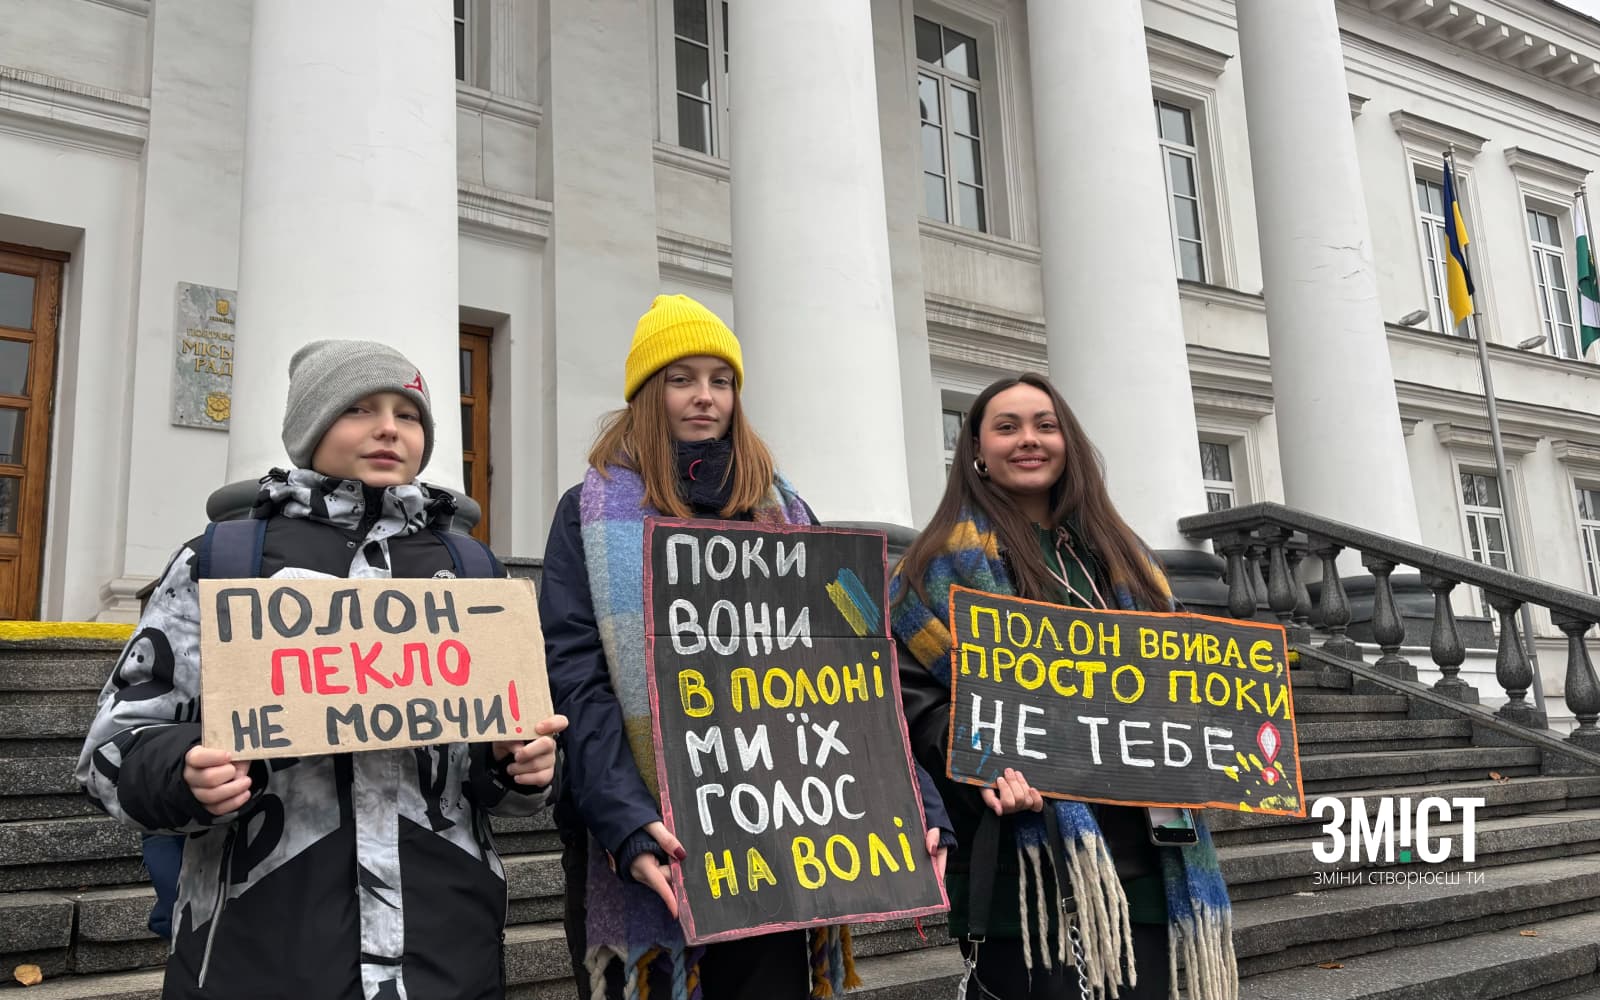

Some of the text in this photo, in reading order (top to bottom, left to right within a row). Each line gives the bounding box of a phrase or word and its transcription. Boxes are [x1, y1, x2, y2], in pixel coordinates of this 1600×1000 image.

[182, 340, 234, 360] МІСЬ
[194, 358, 233, 377] РАД
[666, 533, 806, 585] ПОКИ
[668, 598, 813, 656] ВОНИ
[969, 605, 1284, 679] ПОЛОН ВБИВАЄ,
[271, 639, 471, 696] ПЕКЛО
[678, 668, 715, 718] В
[960, 642, 1292, 720] ПРОСТО ПОКИ
[231, 680, 523, 752] НЕ МОВЧИ!
[685, 712, 850, 777] МИ ЇХ
[970, 692, 1048, 760] НЕ
[696, 773, 866, 836] ГОЛОС
[704, 847, 777, 899] НА
